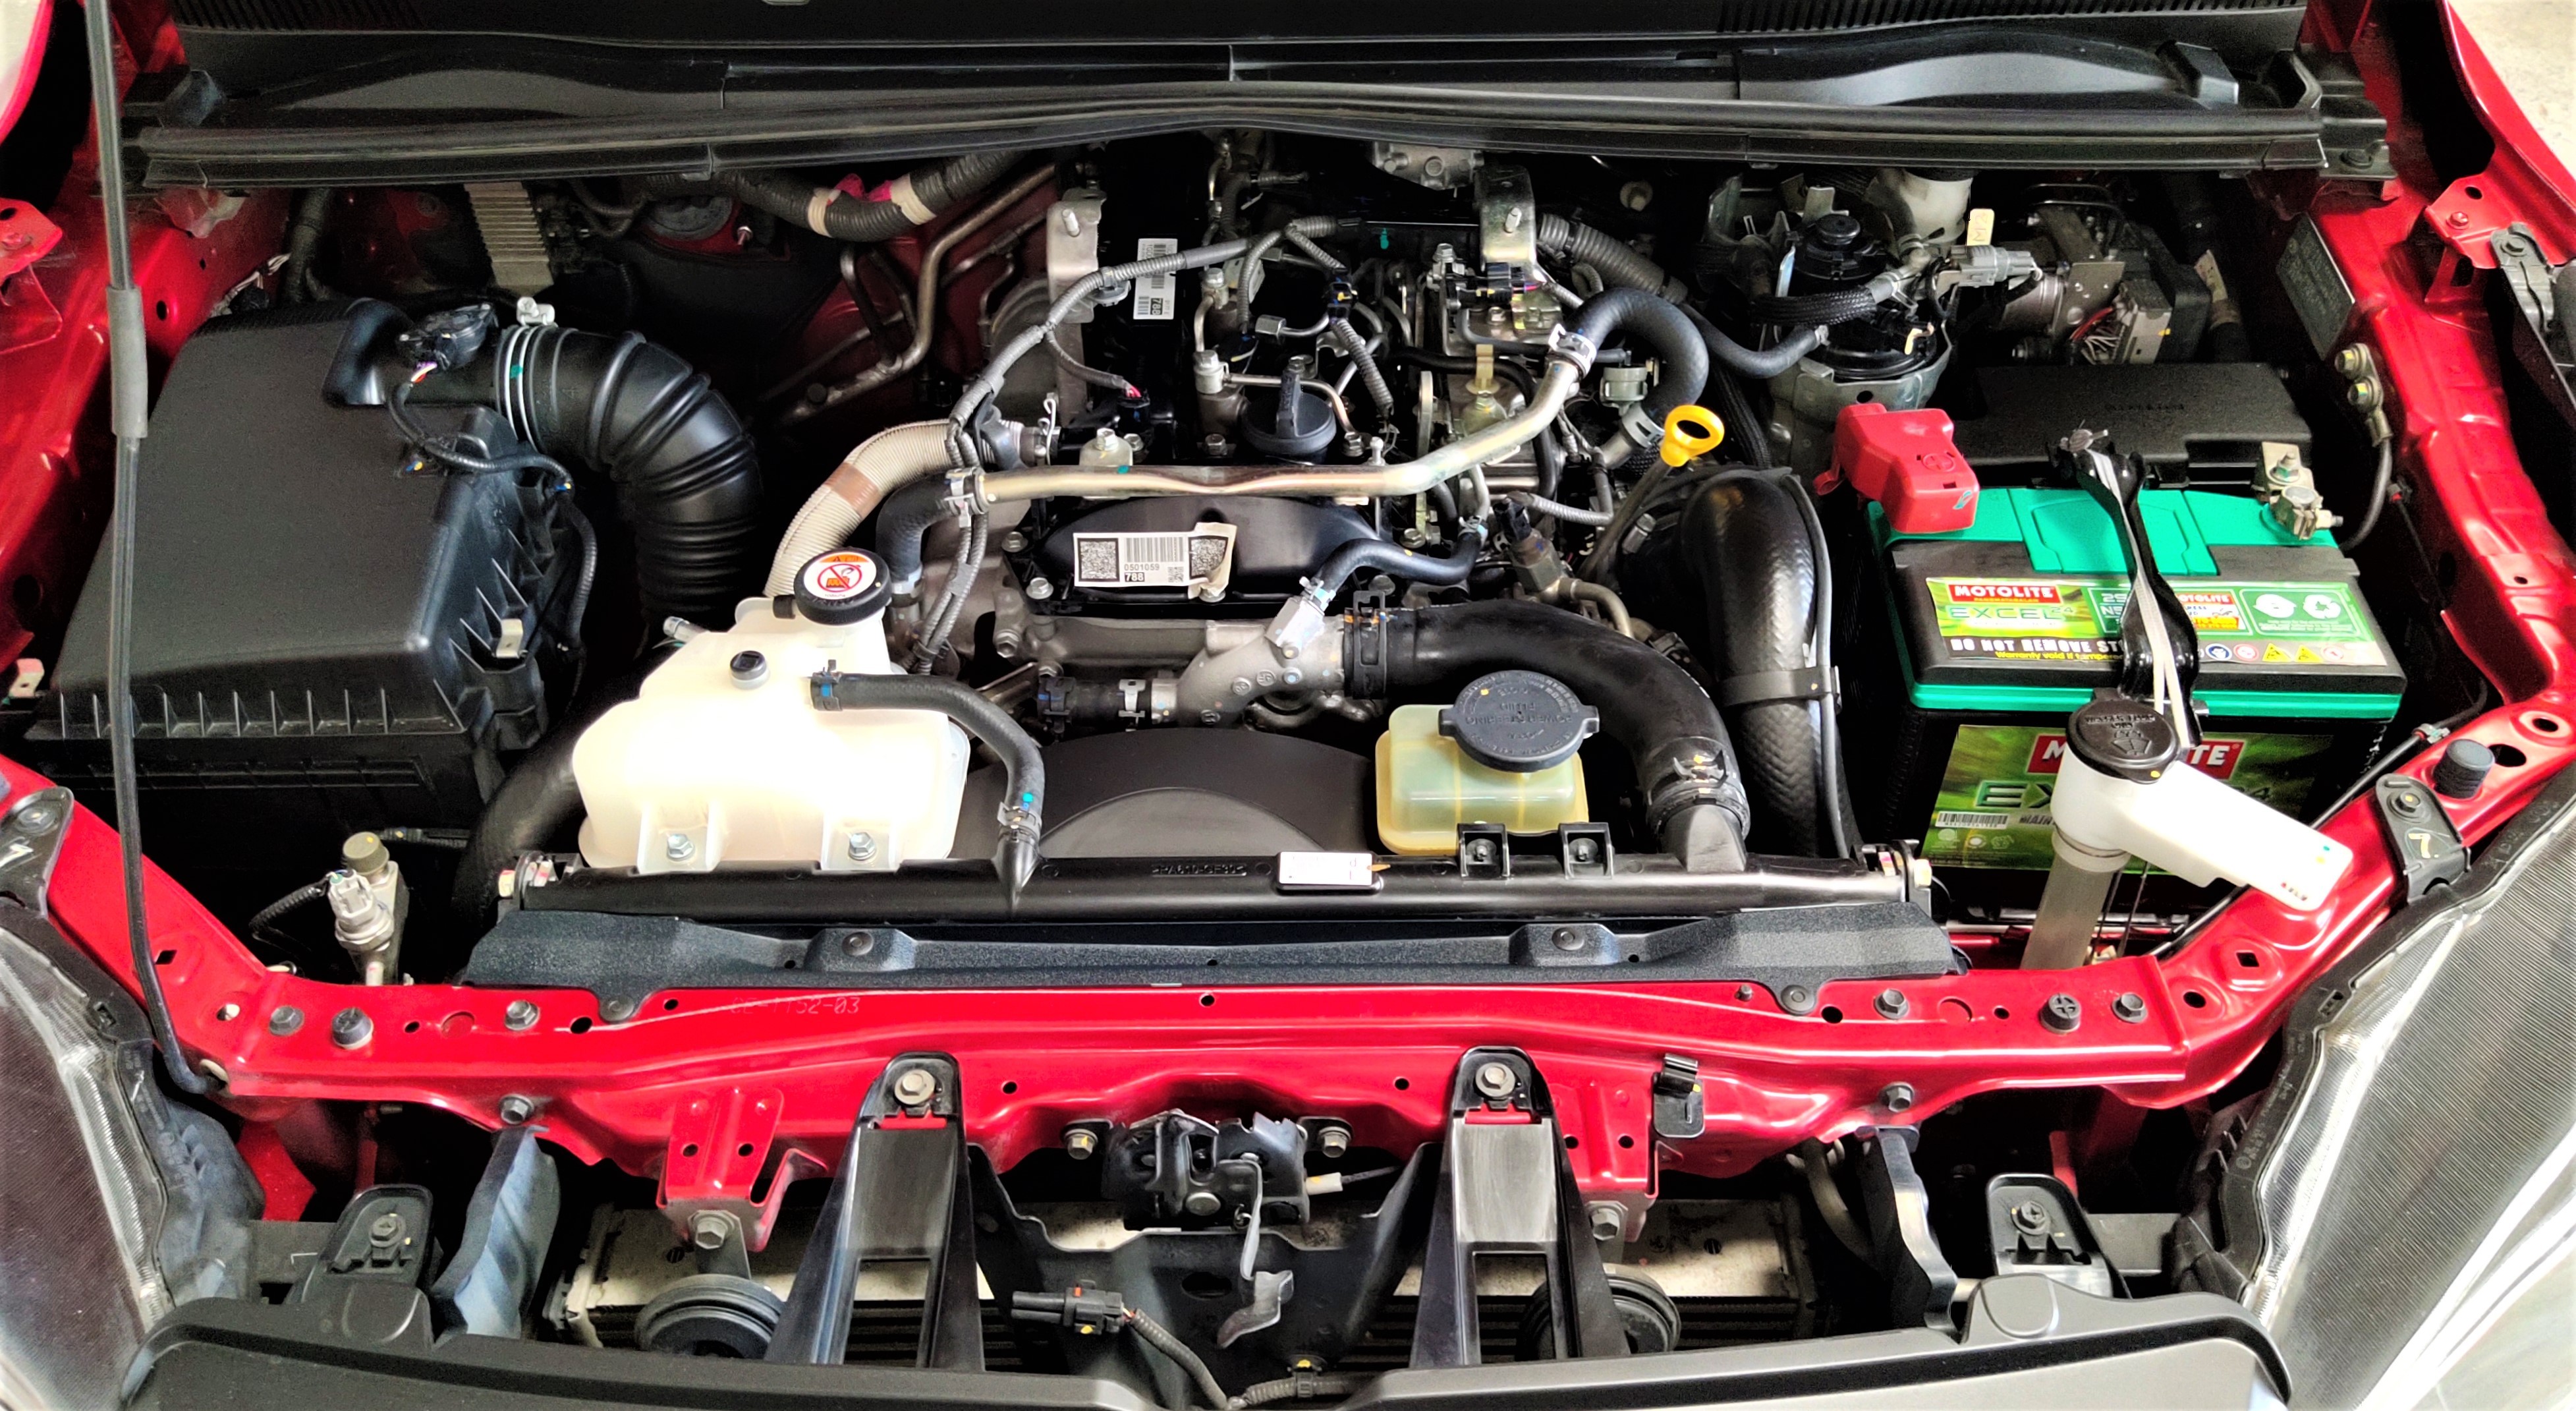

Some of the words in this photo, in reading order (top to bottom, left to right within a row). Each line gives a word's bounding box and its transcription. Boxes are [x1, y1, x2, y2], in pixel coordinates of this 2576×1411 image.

[1152, 299, 1162, 315] 788
[1954, 585, 2054, 598] MOTOLITE
[2178, 594, 2229, 603] OTOLITE
[1949, 607, 2062, 619] EXCEL
[1950, 639, 1975, 651] DO
[1980, 639, 2014, 652] NOT
[2021, 639, 2092, 652] REMOVE
[1995, 651, 2041, 660] Warranty
